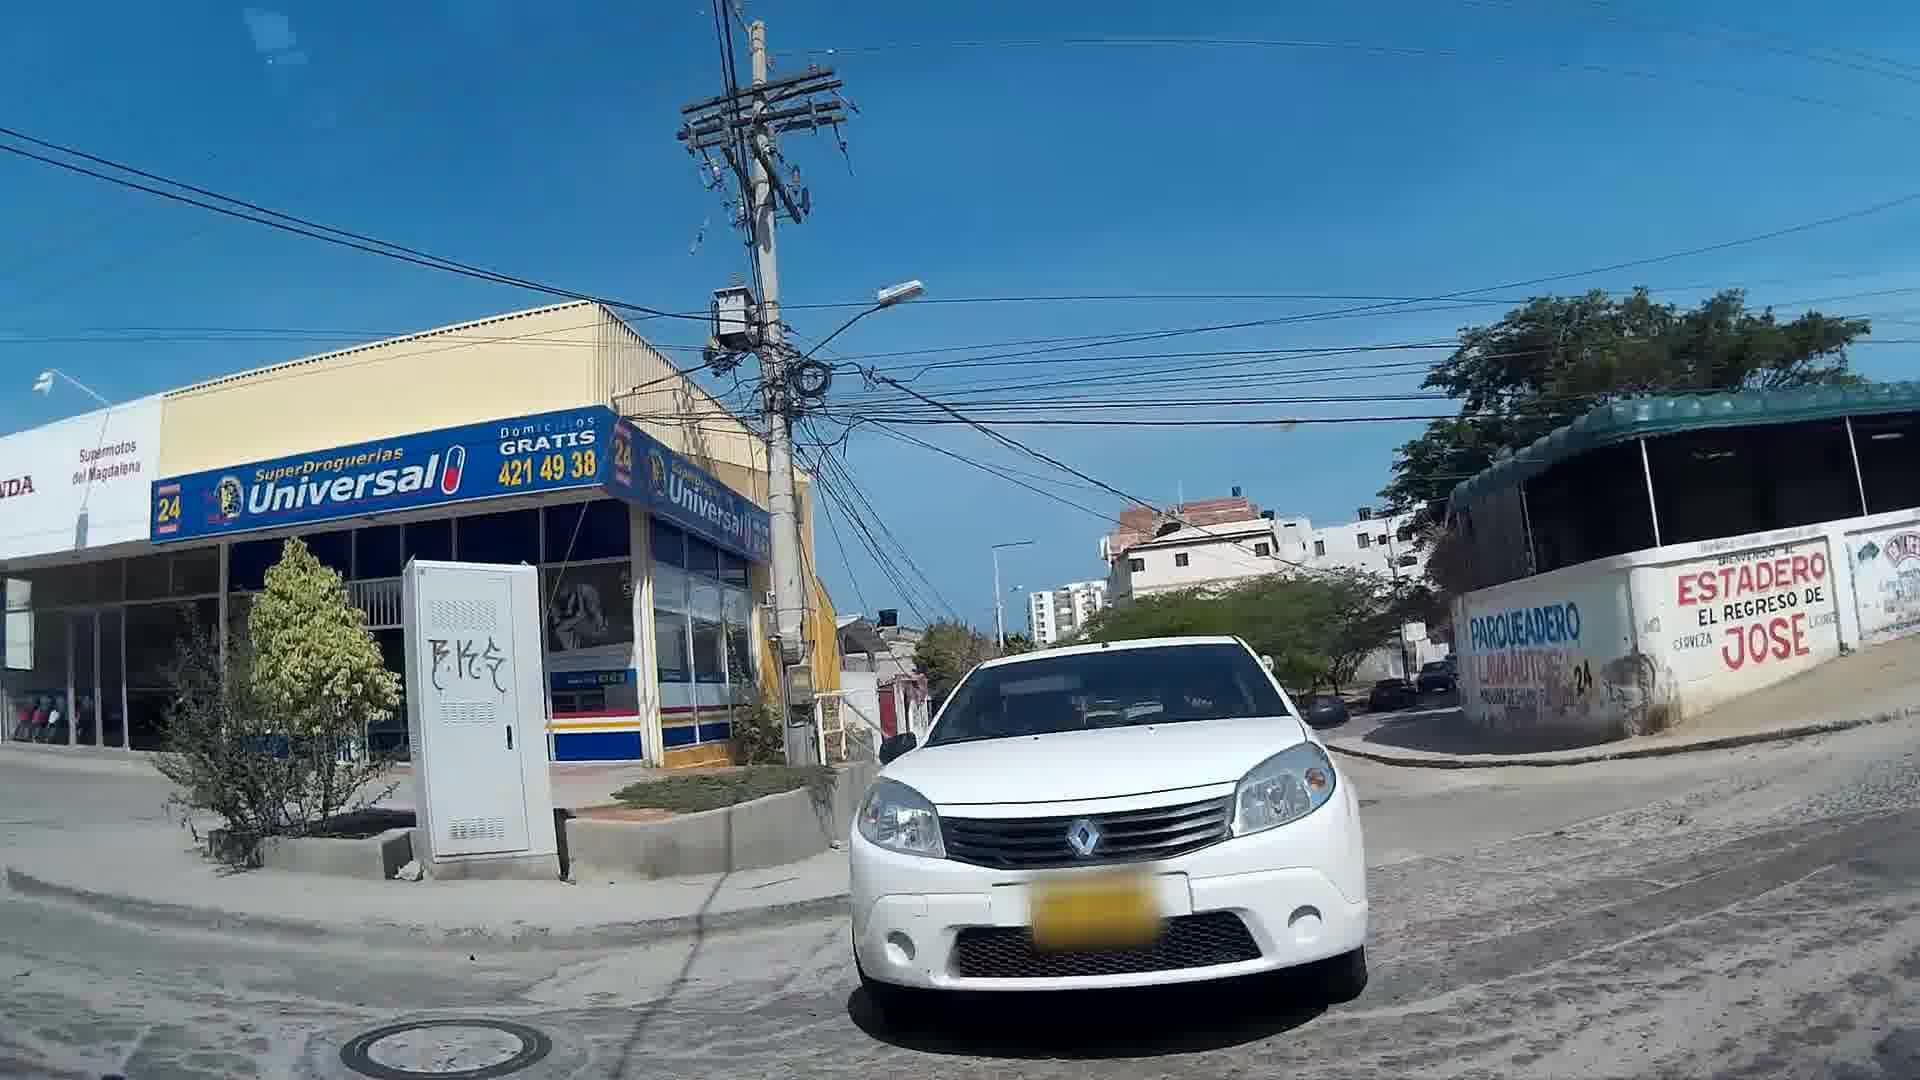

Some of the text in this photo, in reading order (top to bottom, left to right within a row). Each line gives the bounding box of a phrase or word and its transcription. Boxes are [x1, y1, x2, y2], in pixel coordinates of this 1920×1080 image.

[500, 416, 595, 438] Domicios
[500, 430, 596, 455] GRATIS
[80, 441, 137, 463] Supermotos
[89, 460, 141, 482] Magdalena
[255, 448, 403, 483] SuperDroguerias
[498, 448, 597, 487] 421 49 38
[249, 454, 439, 514] Universal
[159, 495, 180, 522] 24
[669, 473, 745, 538] Universal
[1678, 552, 1825, 606] ESTADERO
[1470, 601, 1580, 651] PARQUEADERO
[1698, 587, 1824, 626] EL REGRESO DE
[1721, 613, 1809, 671] JOSE
